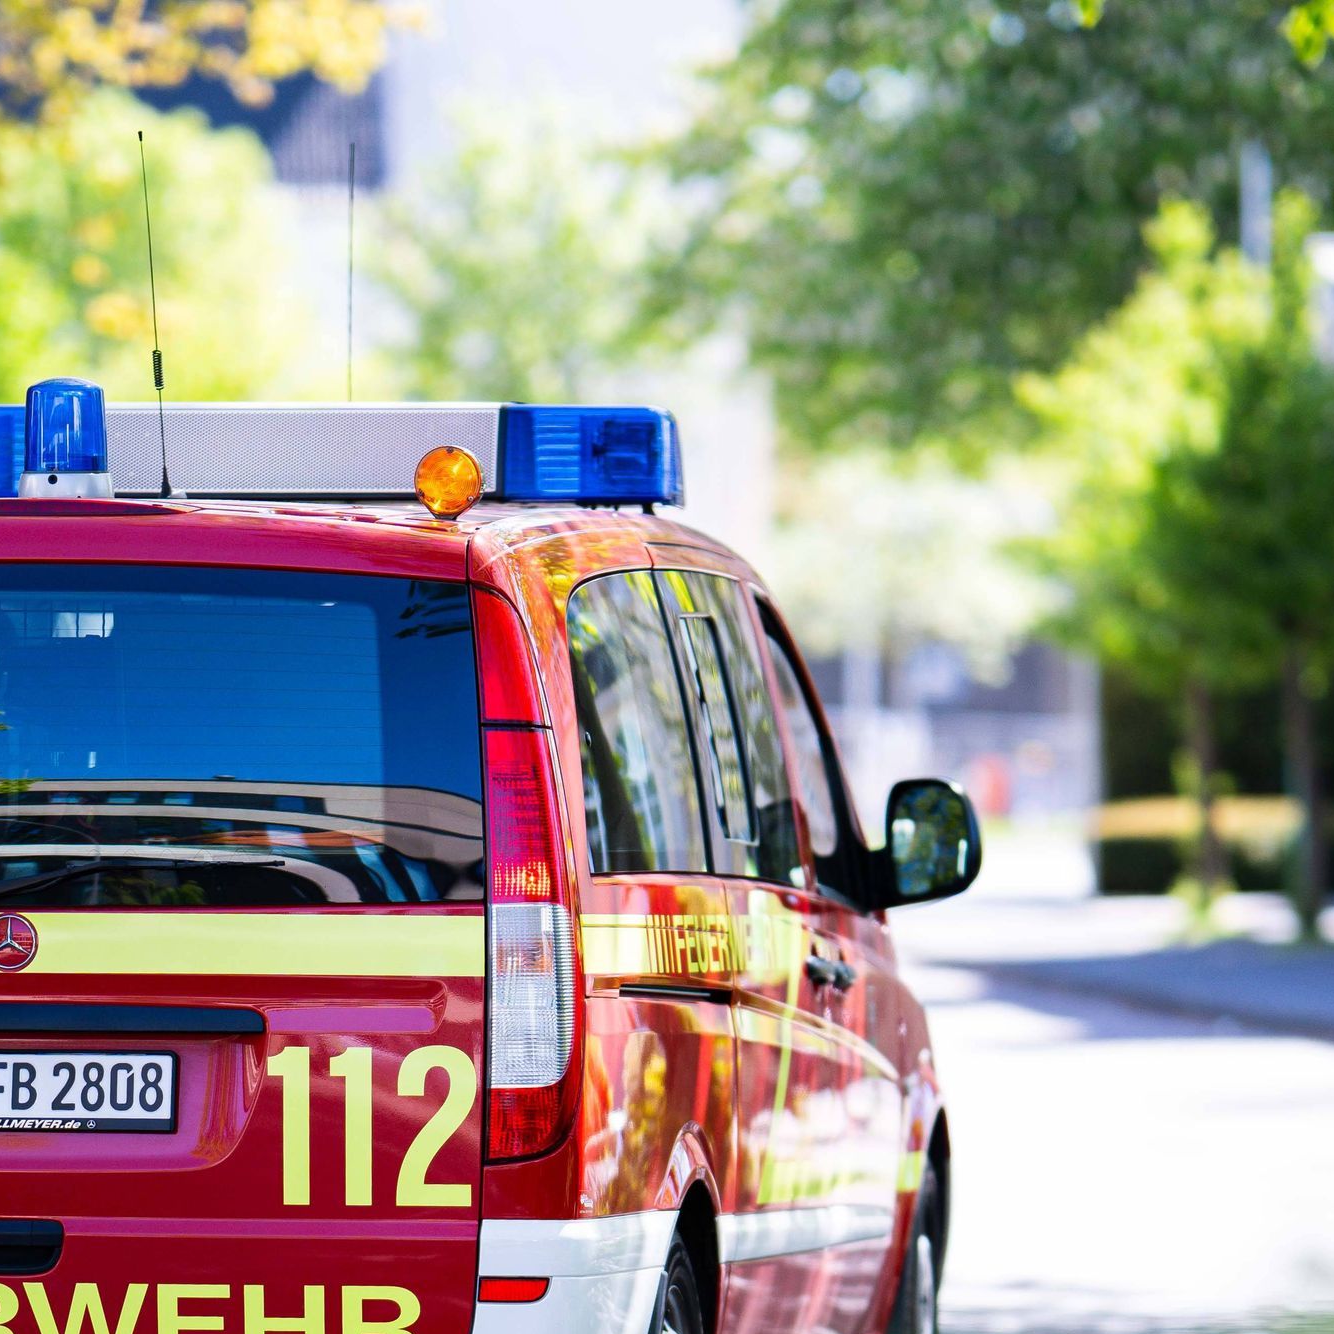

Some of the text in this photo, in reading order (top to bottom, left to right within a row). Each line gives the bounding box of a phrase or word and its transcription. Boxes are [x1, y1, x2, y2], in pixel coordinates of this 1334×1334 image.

[672, 914, 773, 974] FEUERWE
[51, 1062, 164, 1112] 2808
[267, 1044, 477, 1207] 112
